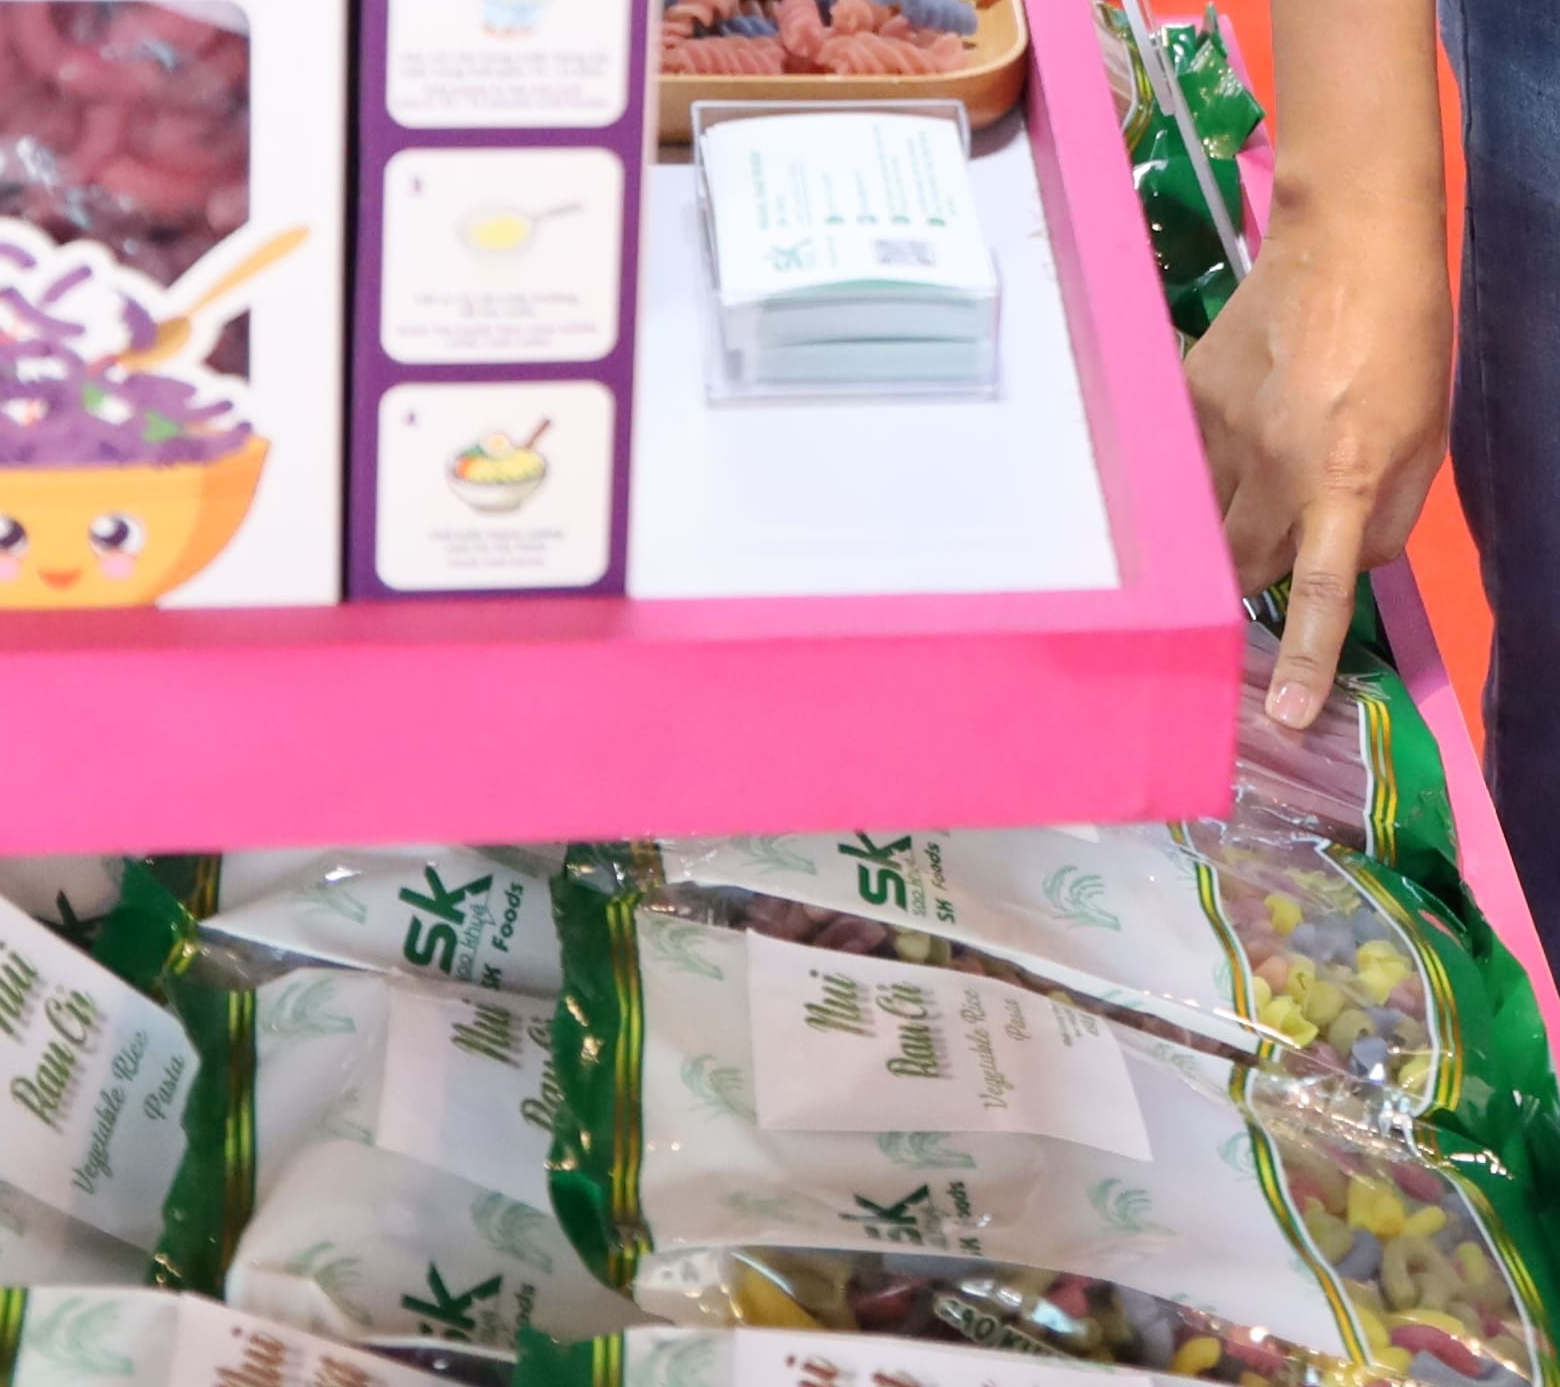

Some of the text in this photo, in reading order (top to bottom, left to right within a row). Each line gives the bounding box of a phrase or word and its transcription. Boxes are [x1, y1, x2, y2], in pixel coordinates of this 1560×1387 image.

[490, 881, 523, 953] Foods
[142, 1054, 184, 1121] Pasta
[972, 1028, 1016, 1110] Vegetable
[72, 1028, 148, 1195] Vegetable Rice
